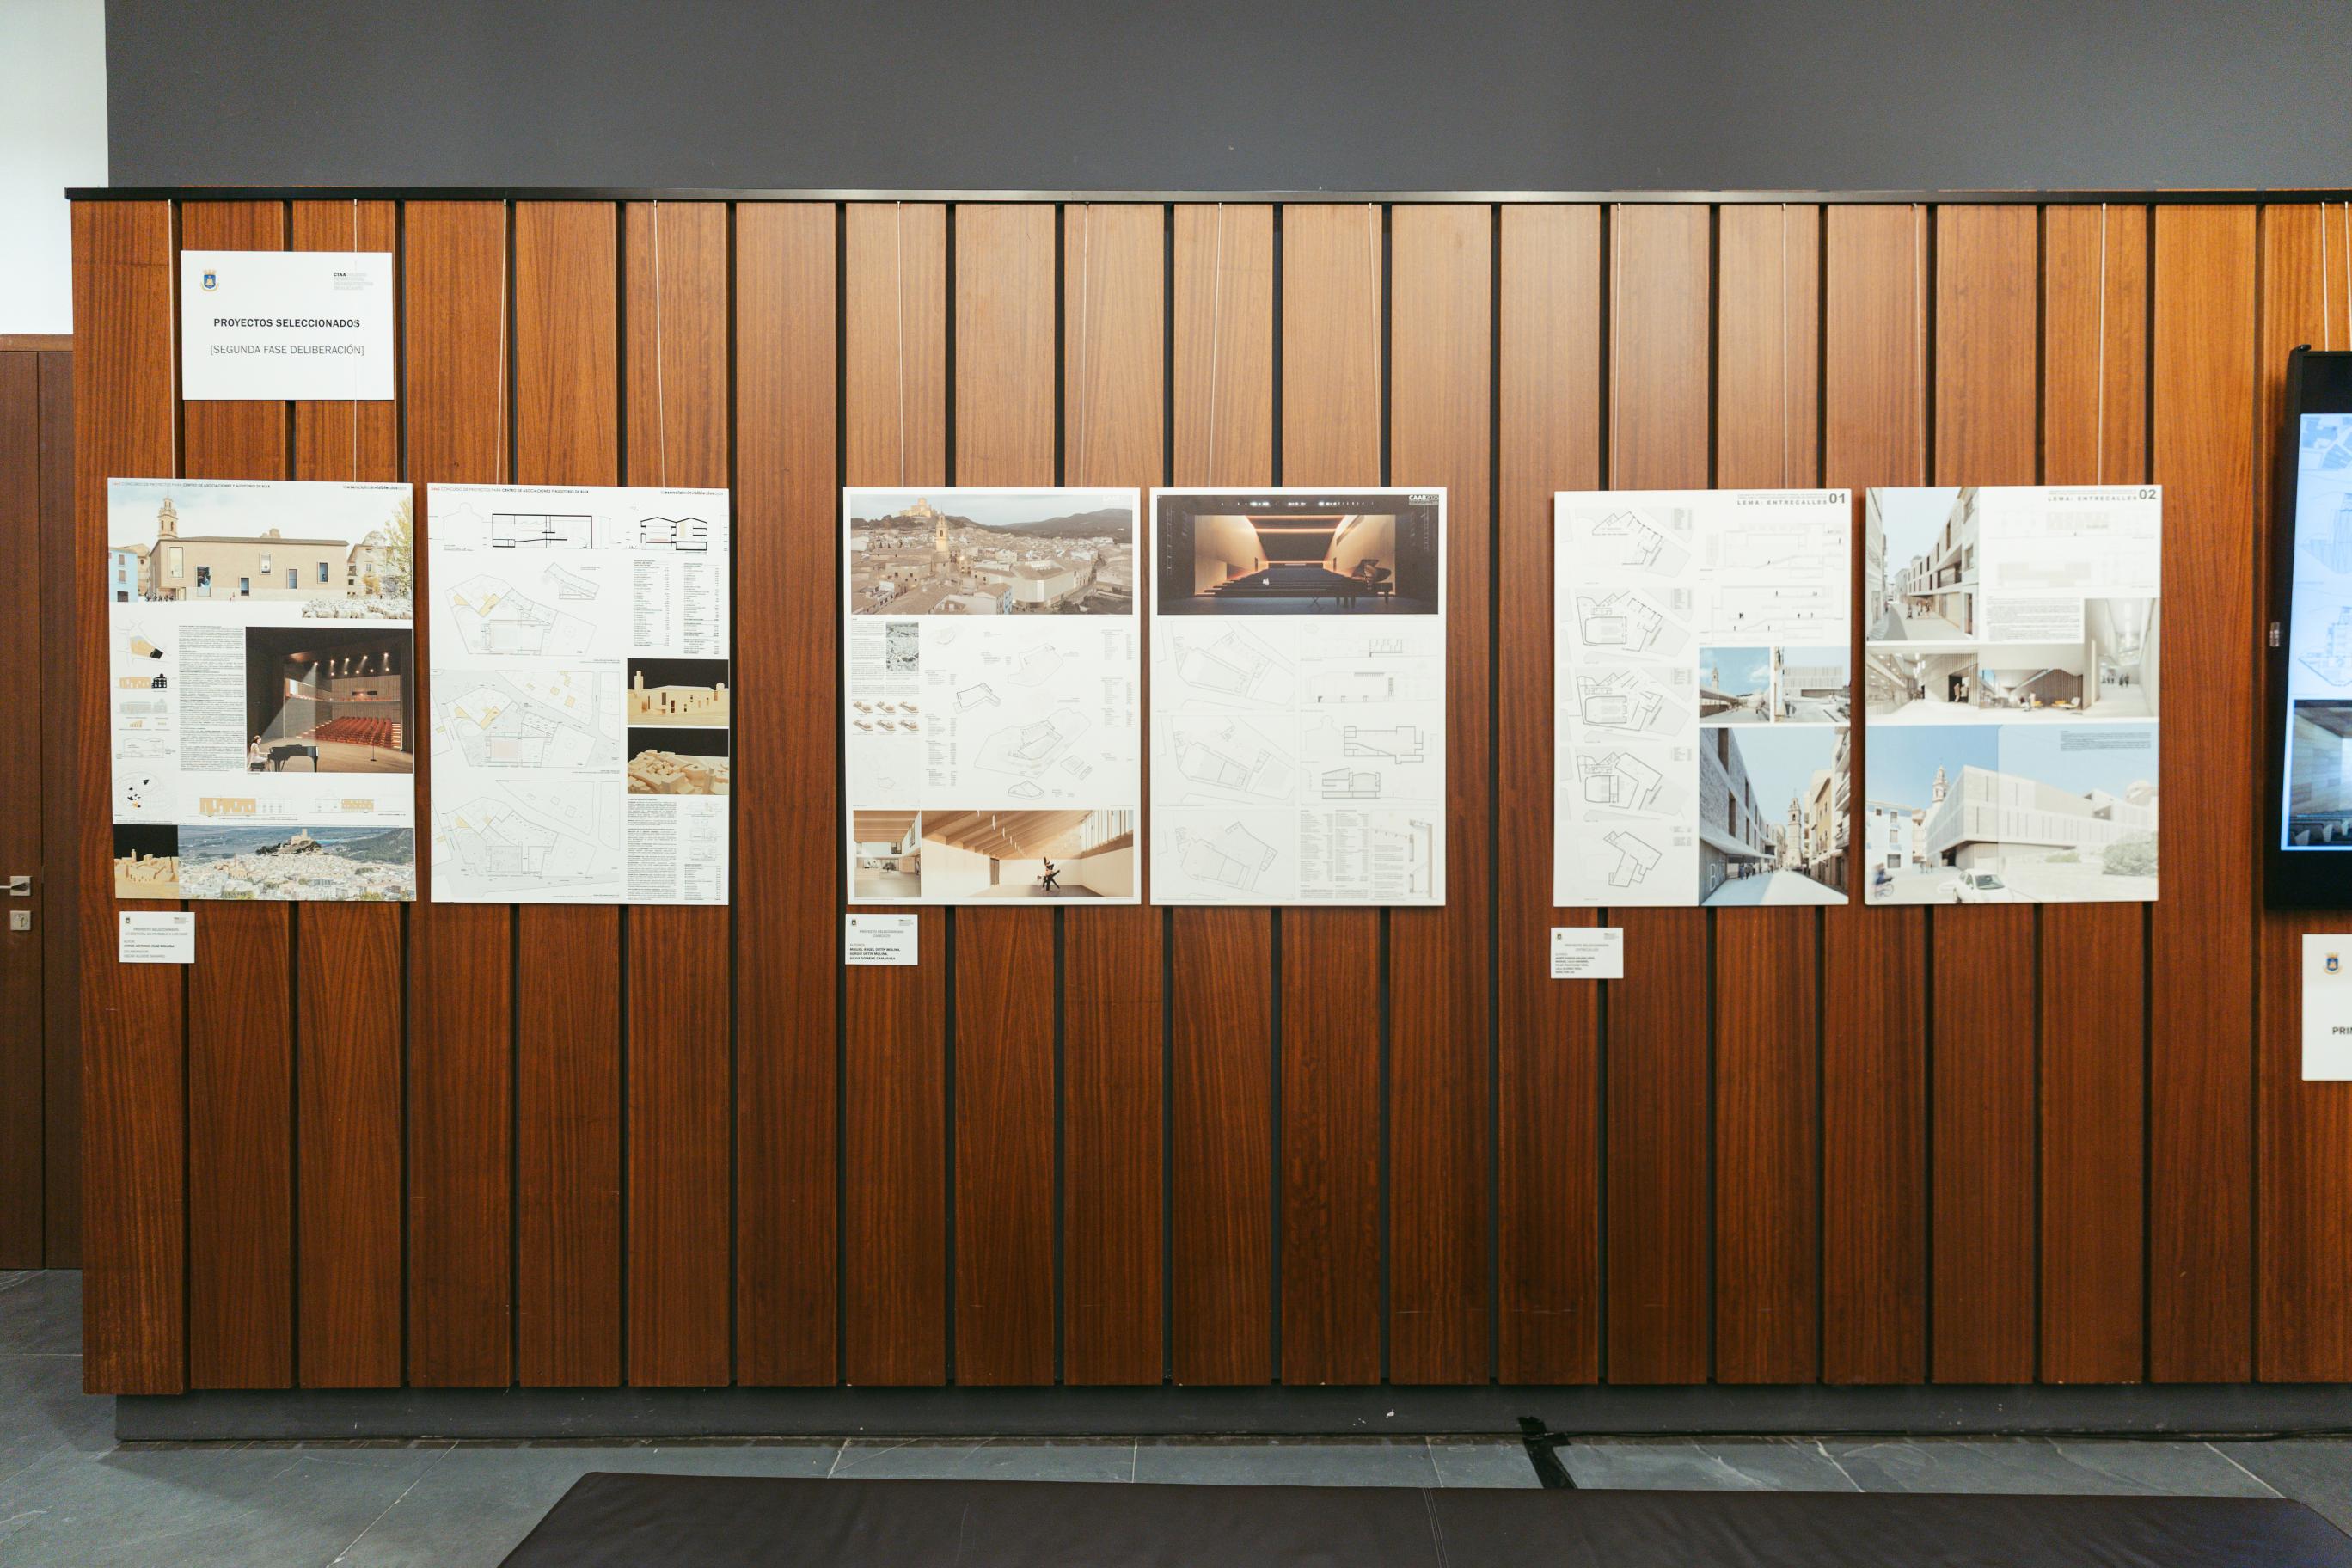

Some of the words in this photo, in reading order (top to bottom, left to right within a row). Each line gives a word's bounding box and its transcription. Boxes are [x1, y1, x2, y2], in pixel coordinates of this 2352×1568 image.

[213, 318, 273, 328] PROYECTOS
[275, 319, 360, 328] SELECCIONADOS
[210, 346, 261, 356] [SEGUNDA
[263, 346, 287, 354] FASE
[290, 344, 365, 356] DELIBERACIÓN]
[1828, 493, 1846, 504] 01
[2139, 488, 2156, 499] 02
